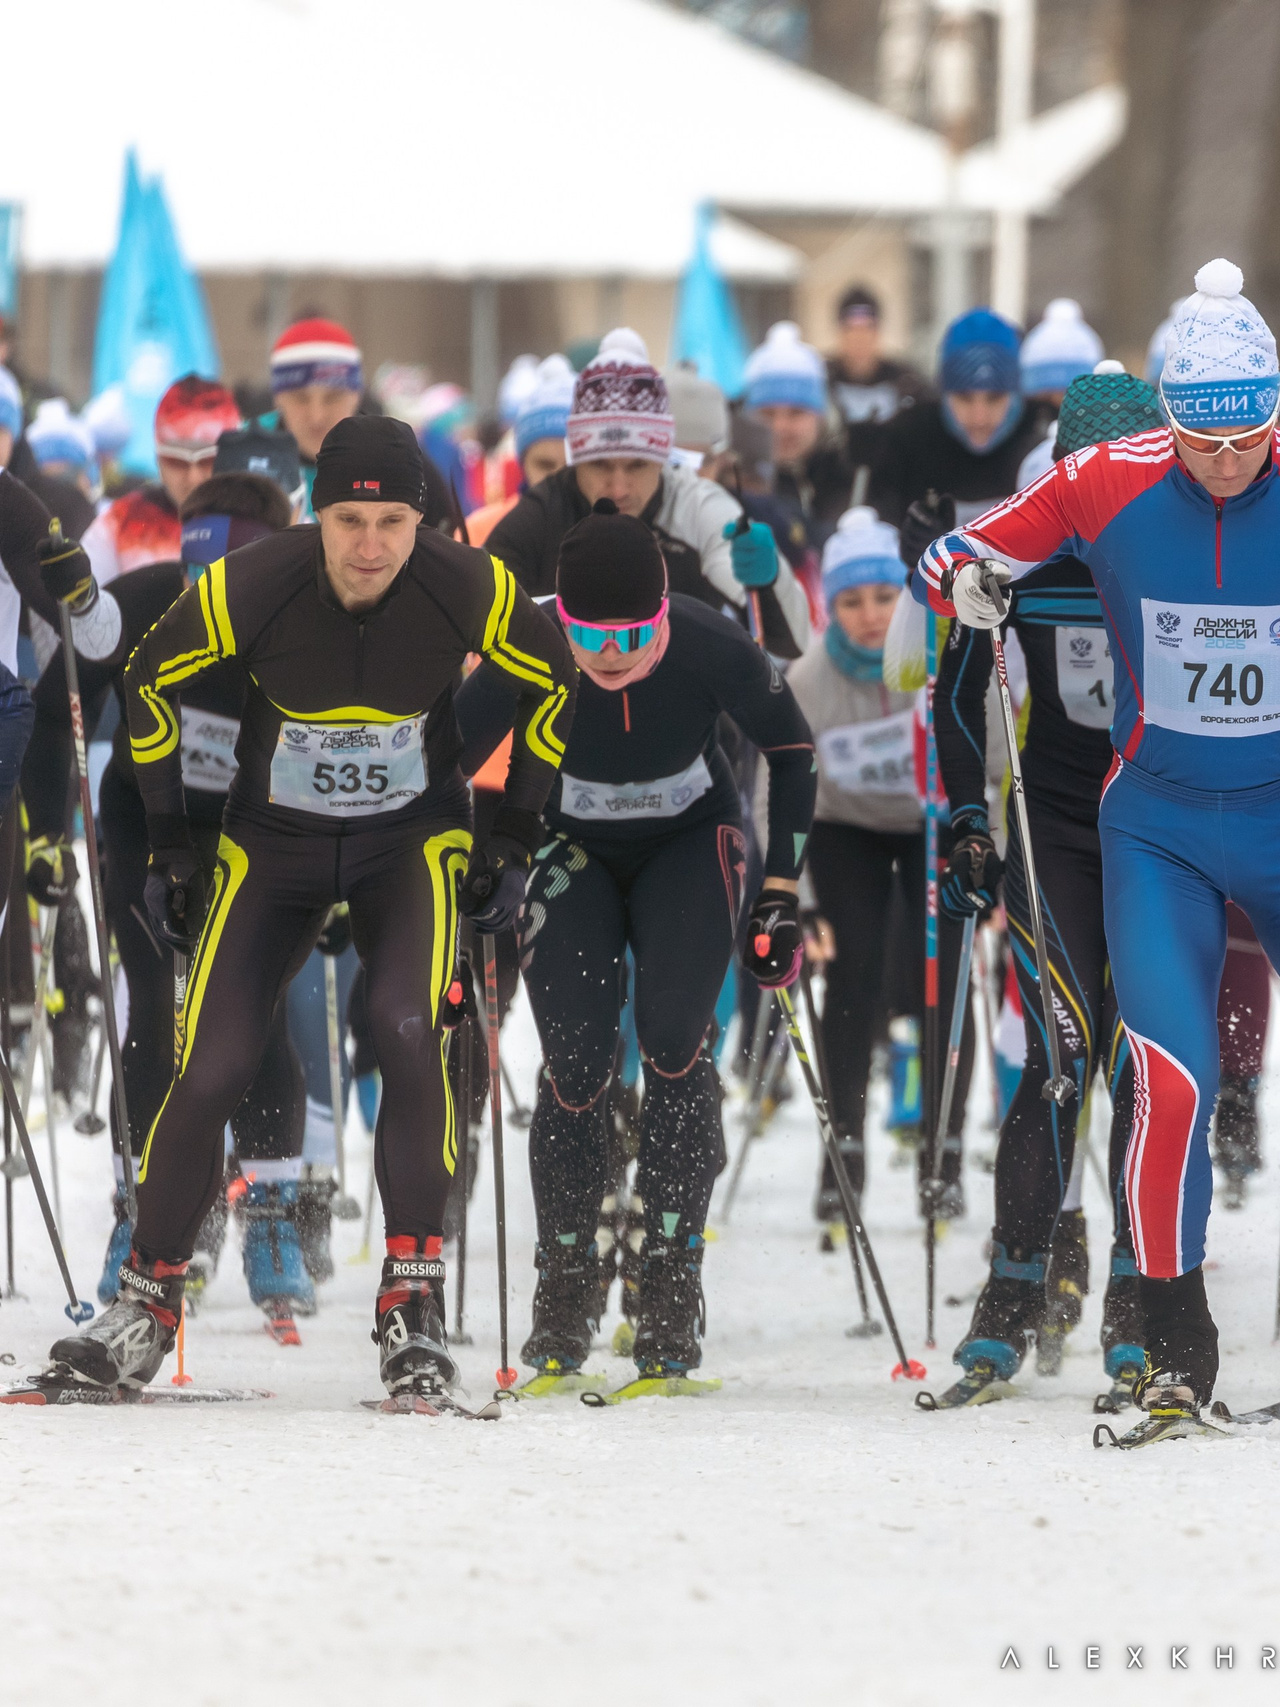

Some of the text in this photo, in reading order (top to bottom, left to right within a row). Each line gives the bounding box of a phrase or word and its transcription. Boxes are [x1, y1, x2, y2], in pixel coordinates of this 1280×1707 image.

[1196, 617, 1256, 629] ЛЫЖНЯ
[1155, 634, 1183, 643] МИНСПОРТ
[1193, 628, 1257, 639] РОССИИ
[1204, 638, 1246, 649] 2025
[994, 639, 1009, 688] SWIX
[1183, 661, 1264, 706] 740
[1201, 715, 1259, 724] ВОРОНЕЖСКАЯ
[323, 734, 379, 744] ЛЫЖНЯ
[320, 741, 380, 750] РОССИИ
[312, 762, 389, 794] 535
[329, 799, 384, 807] ВОРОНЕЖСКАЯ
[1040, 989, 1078, 1036] RAFT
[118, 1265, 165, 1297] OSSIGNOL
